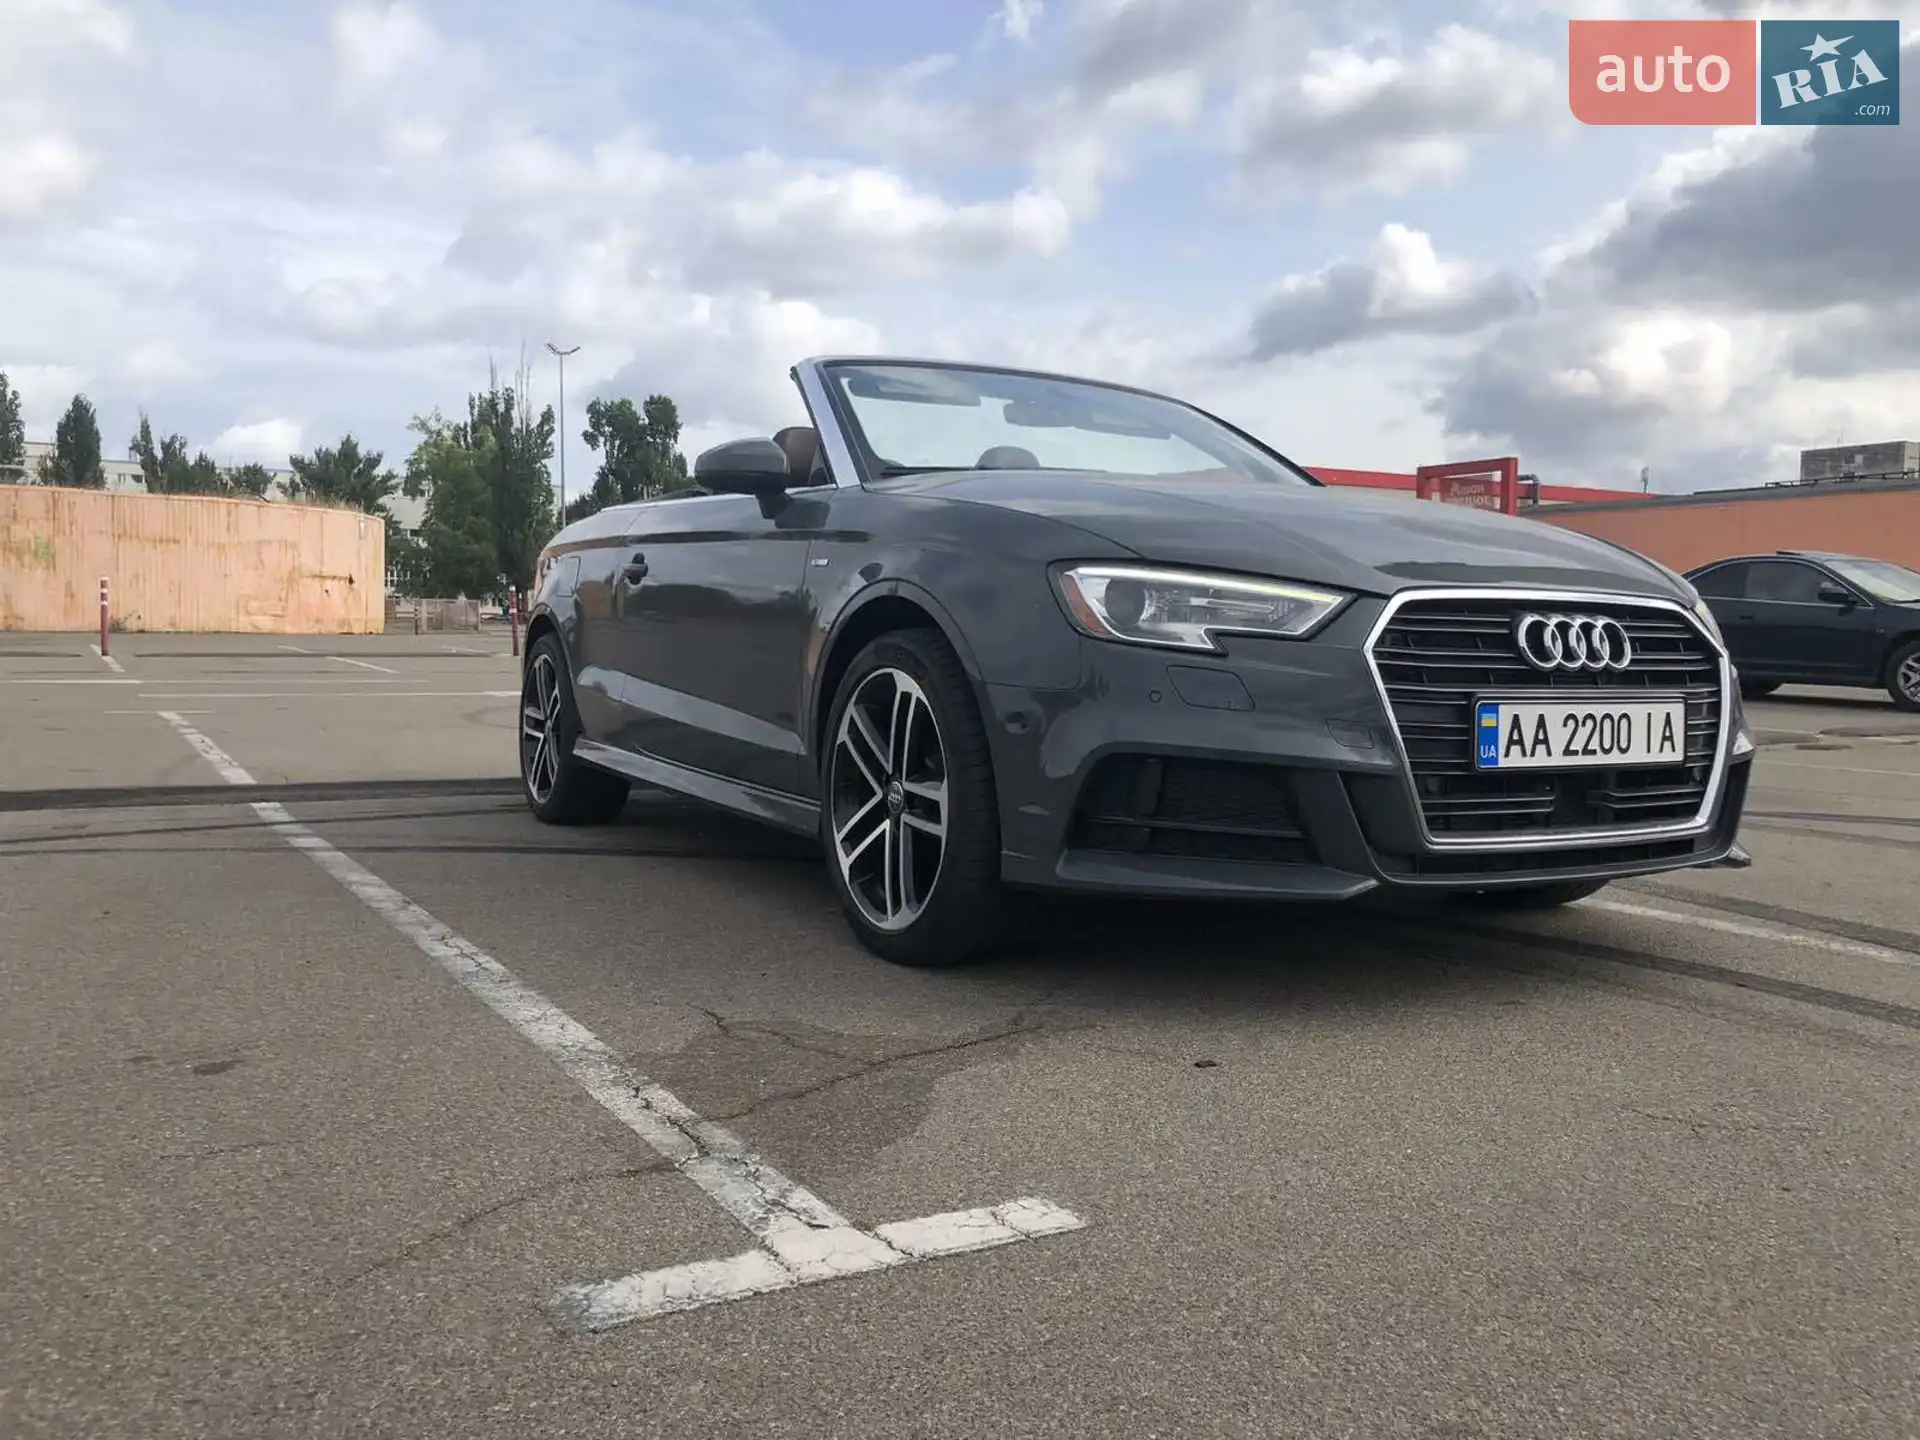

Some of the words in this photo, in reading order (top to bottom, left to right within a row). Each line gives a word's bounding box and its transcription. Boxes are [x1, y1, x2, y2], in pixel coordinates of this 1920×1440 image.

[1503, 713, 1553, 758] AA
[1562, 712, 1632, 756] 2200
[1646, 711, 1676, 754] IA
[1480, 745, 1497, 758] UA
